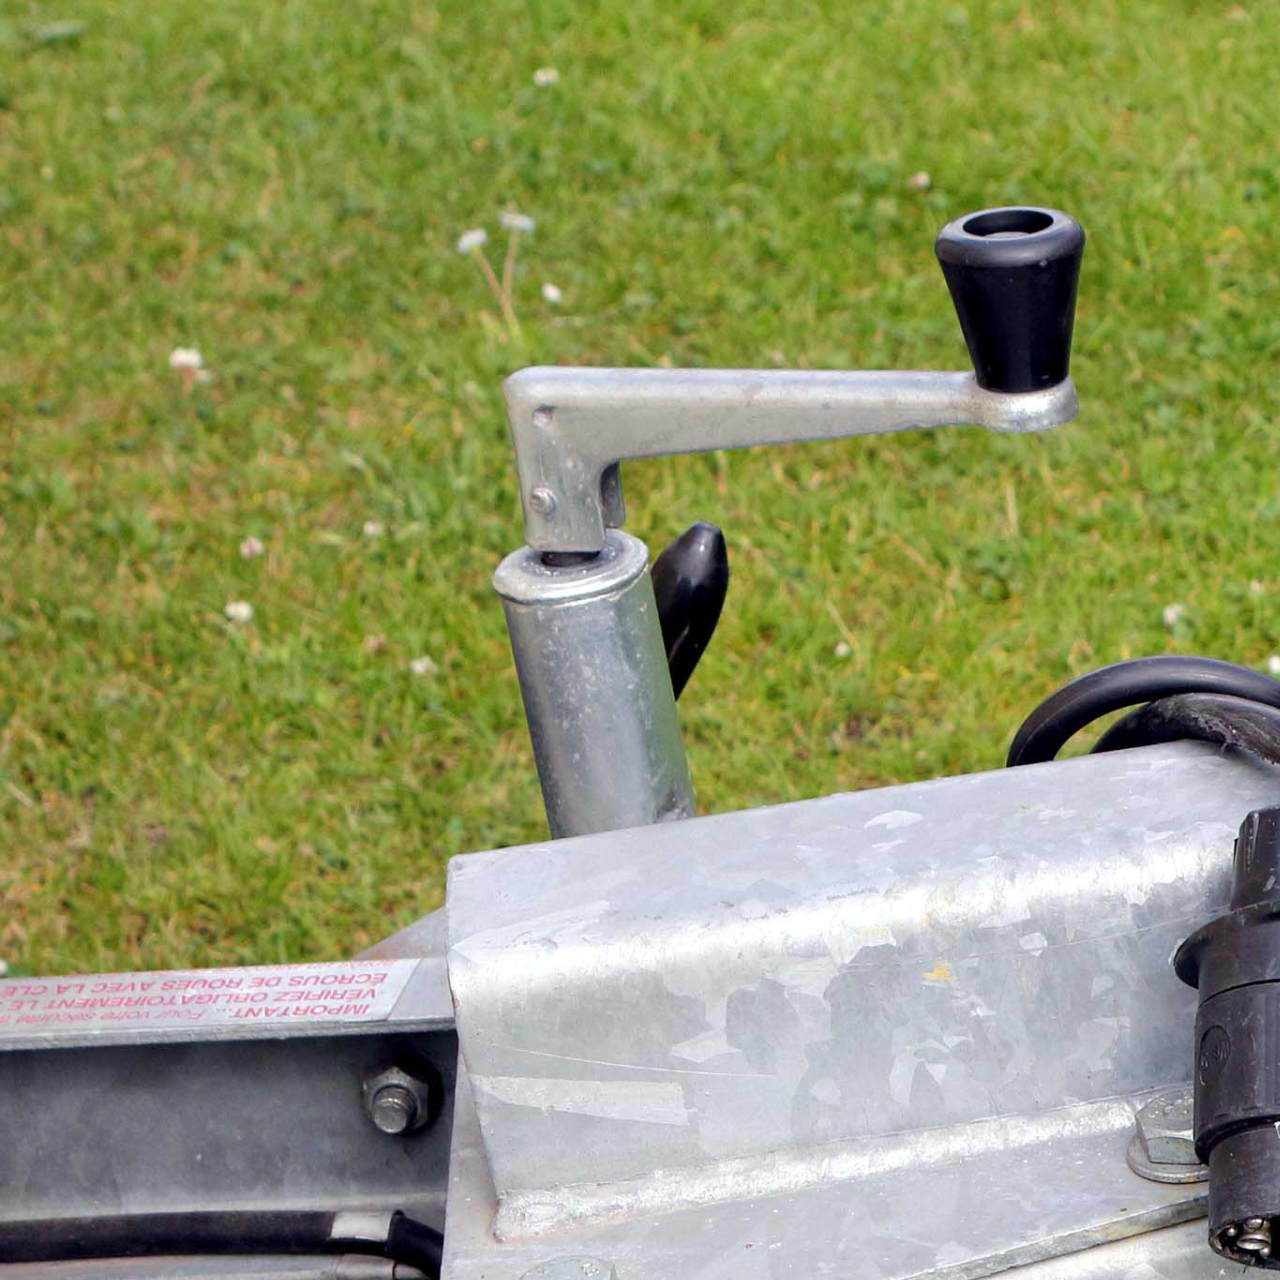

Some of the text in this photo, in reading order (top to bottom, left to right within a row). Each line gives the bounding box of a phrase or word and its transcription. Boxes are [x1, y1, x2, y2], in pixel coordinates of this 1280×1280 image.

[161, 976, 243, 991] ROUES
[251, 976, 282, 987] DE
[288, 973, 388, 986] ÉCROUS
[56, 983, 85, 995] LA
[91, 981, 156, 994] AVEC
[11, 1000, 36, 1010] LE
[43, 991, 268, 1010] OBLIGATOIREMENT
